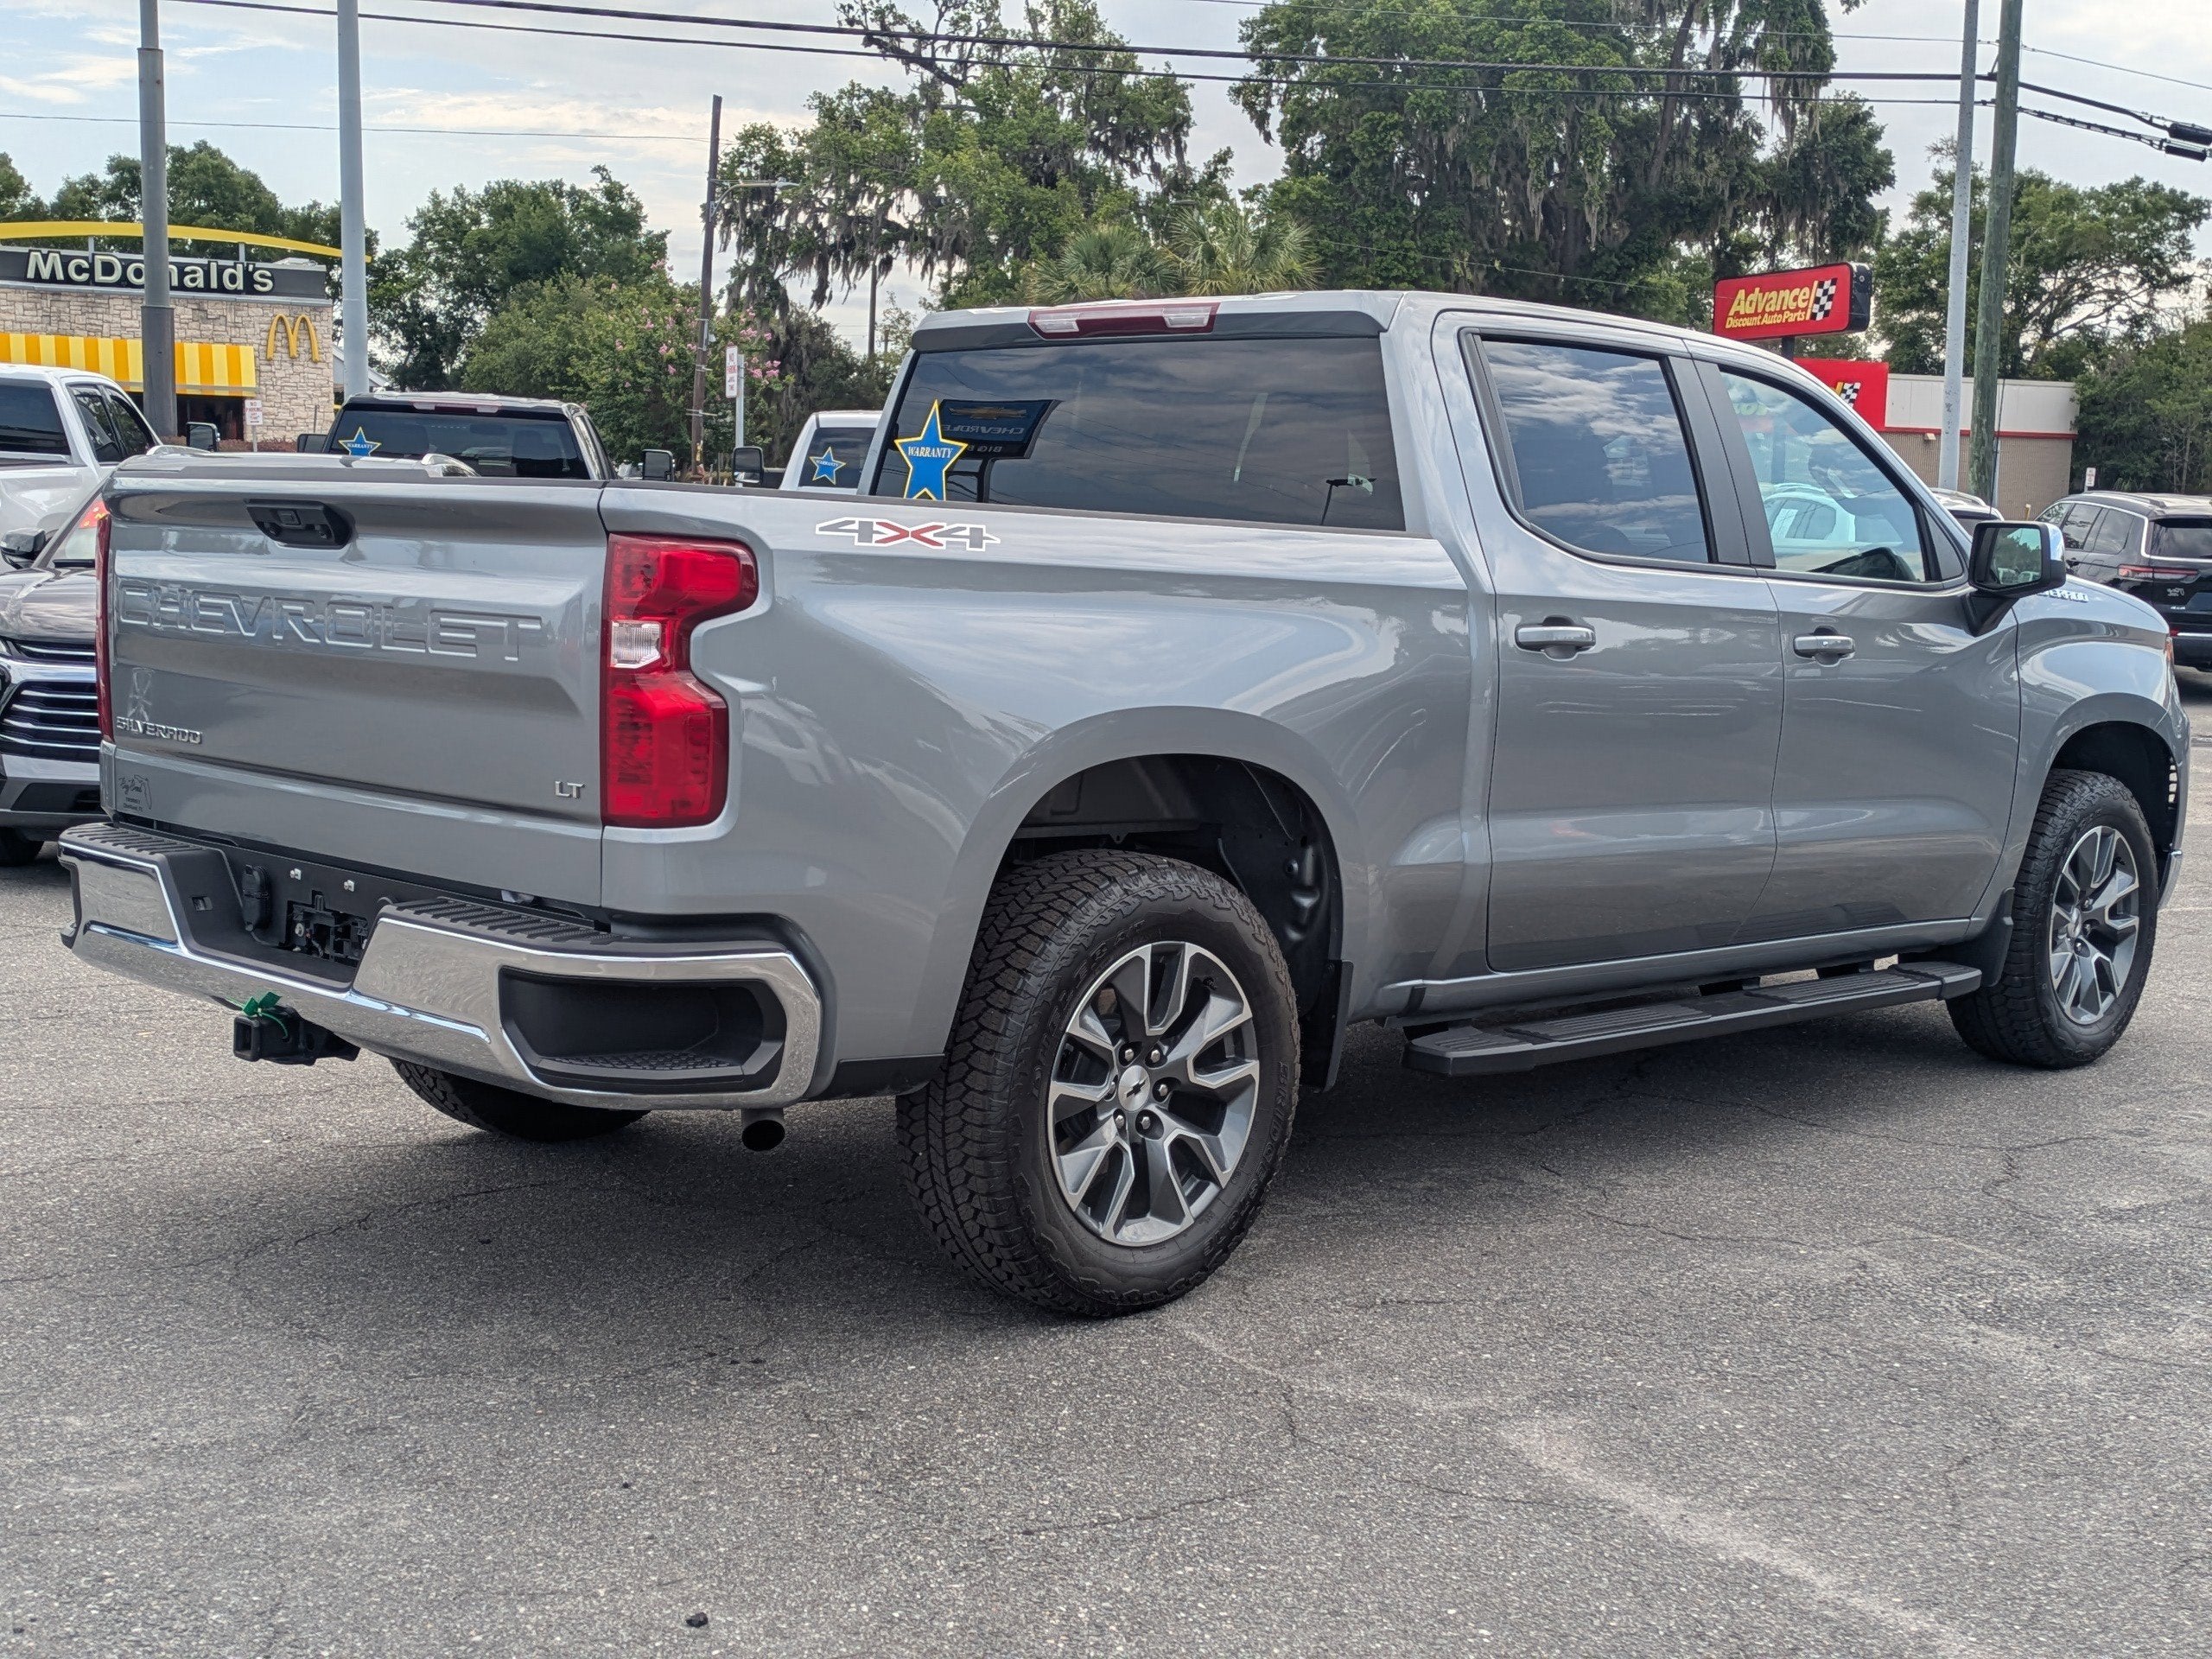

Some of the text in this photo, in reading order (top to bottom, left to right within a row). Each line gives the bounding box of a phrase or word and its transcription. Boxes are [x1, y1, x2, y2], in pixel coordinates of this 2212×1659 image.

[1729, 286, 1810, 316] Advance
[1726, 309, 1806, 328] Discount Auto Parts
[907, 445, 954, 459] WARRANTY
[118, 583, 543, 661] CHEVROLET
[117, 716, 202, 744] SILVERADO
[554, 780, 586, 800] LT
